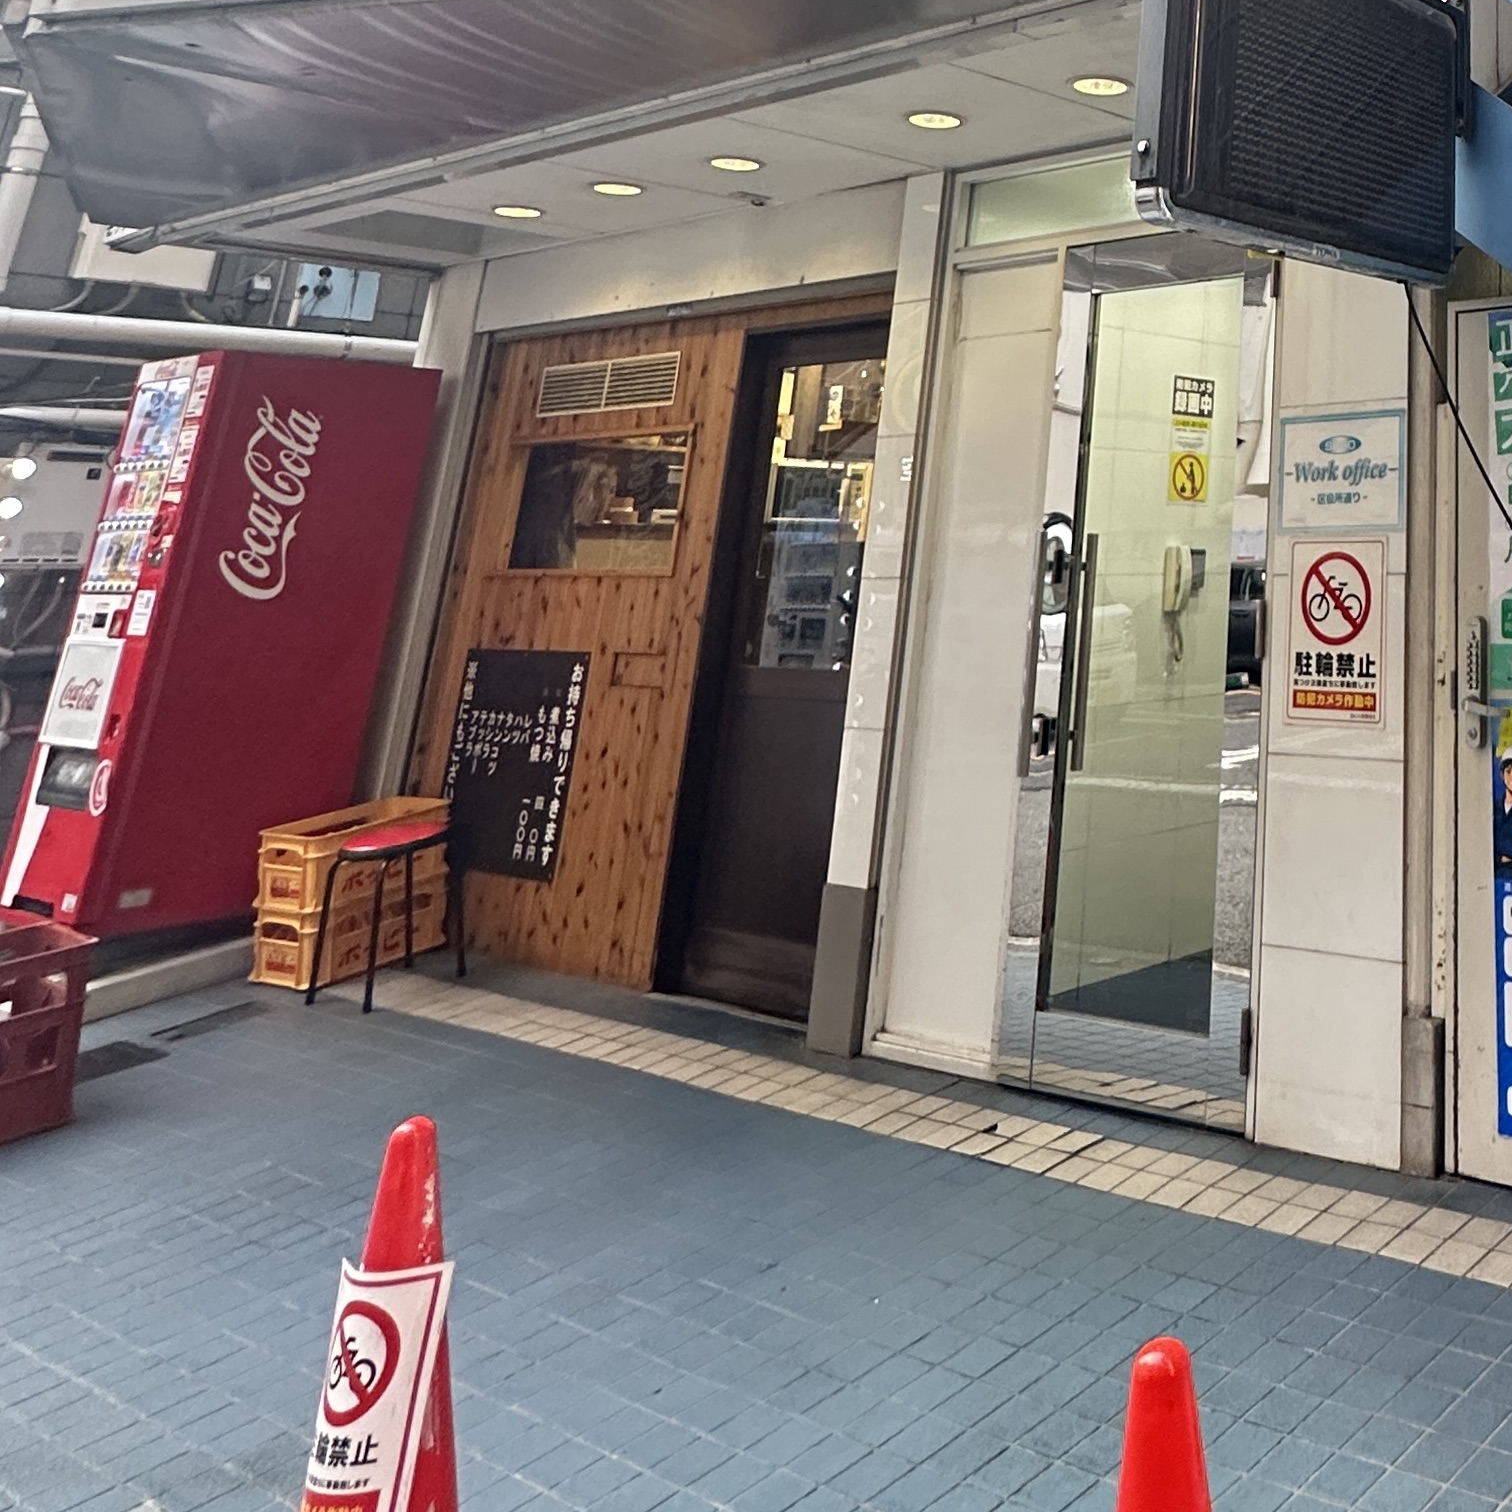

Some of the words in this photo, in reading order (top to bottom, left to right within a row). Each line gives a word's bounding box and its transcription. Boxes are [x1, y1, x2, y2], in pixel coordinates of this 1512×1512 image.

[1294, 651, 1377, 678] 駐輪禁止
[312, 1432, 379, 1468] 輪禁止
